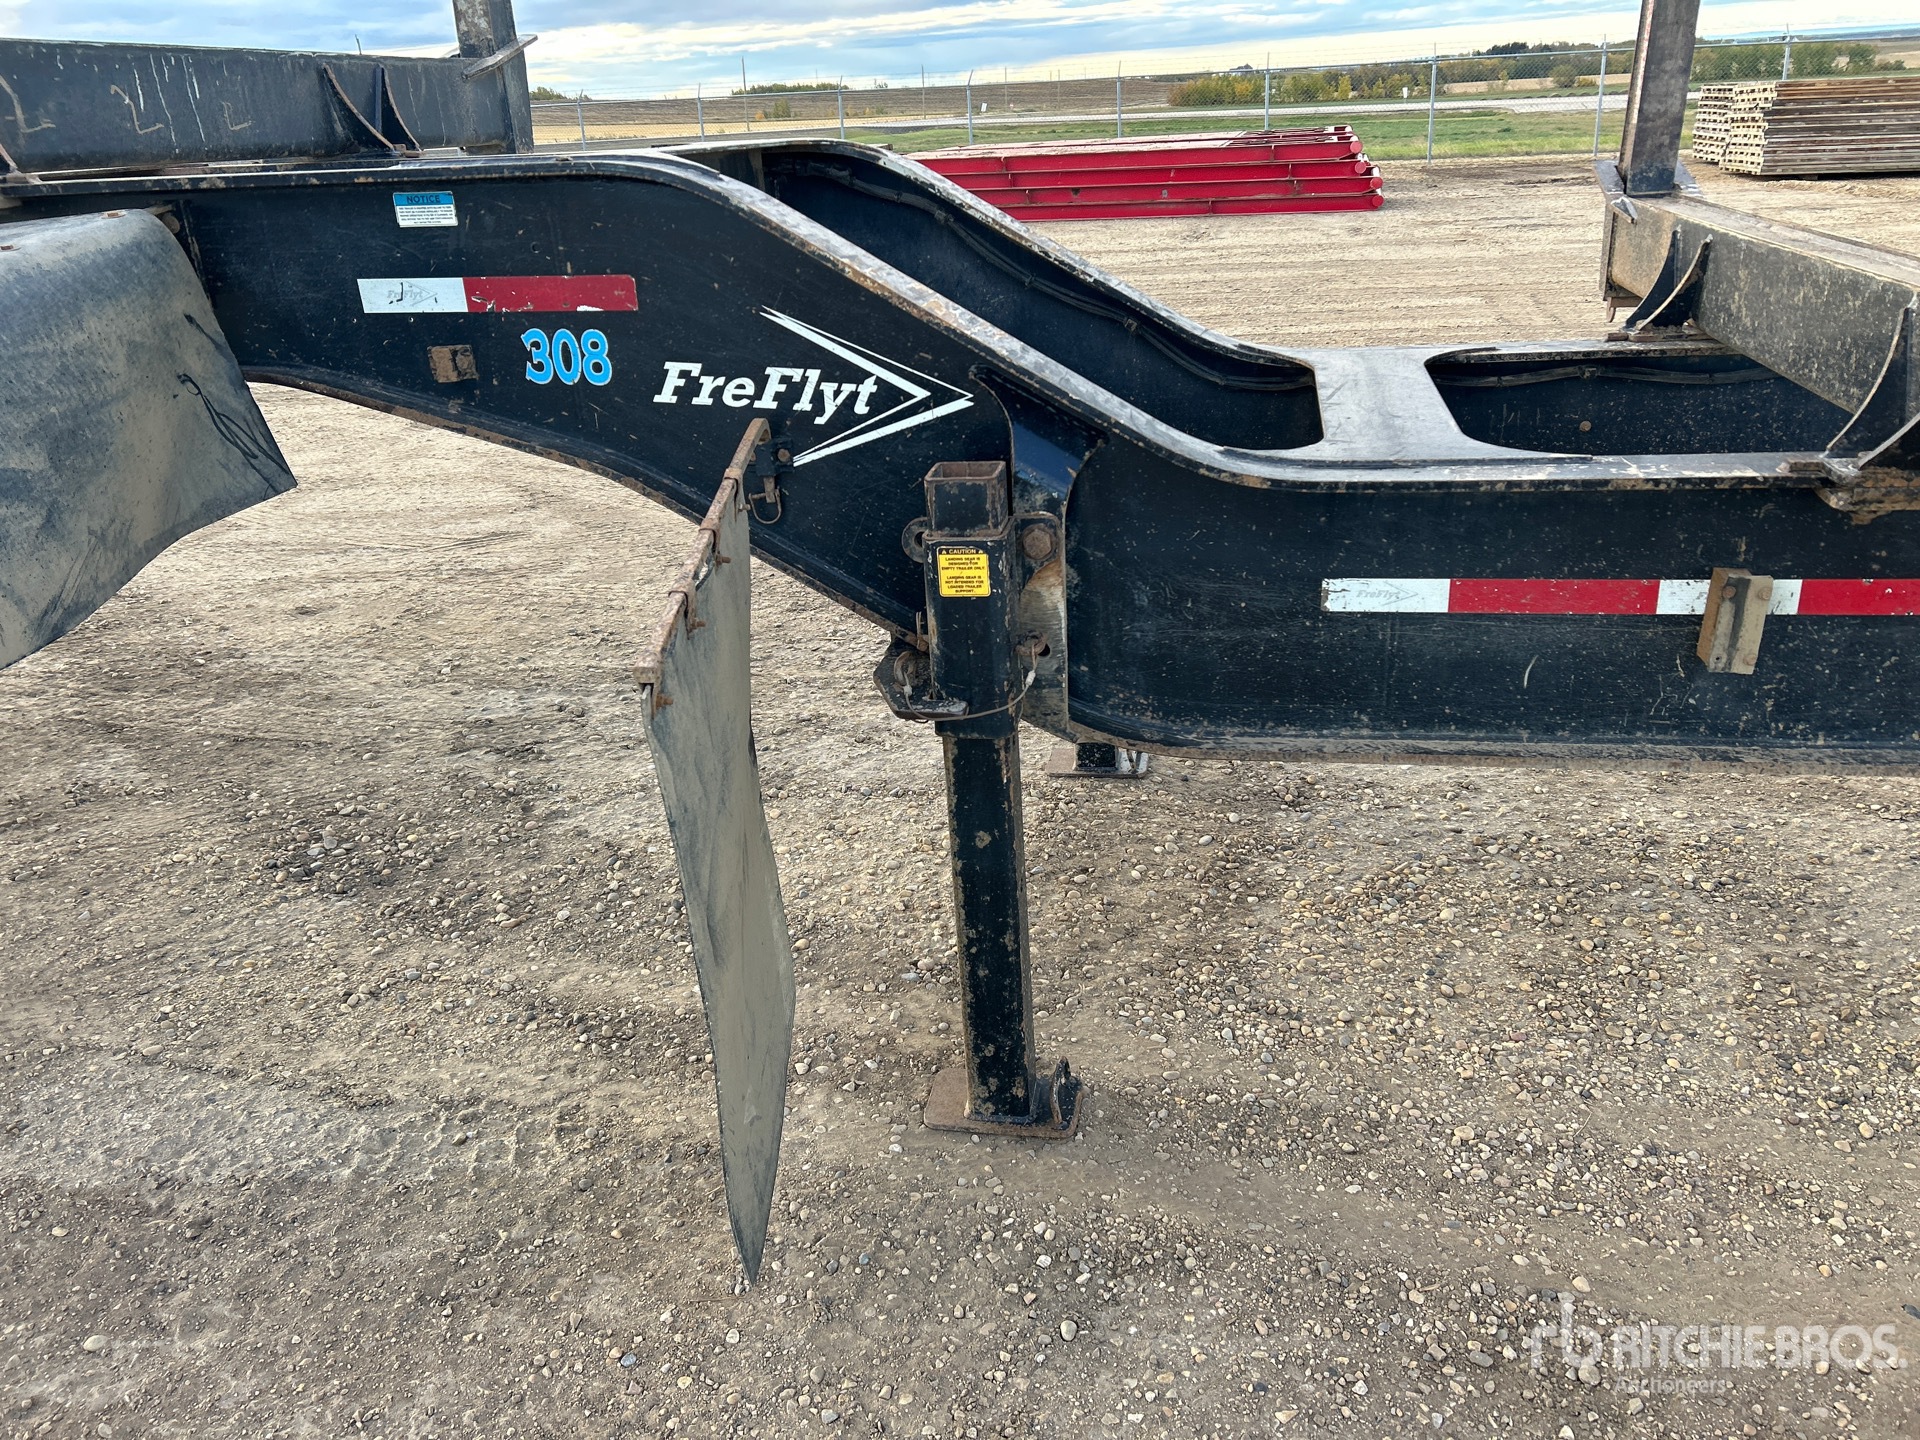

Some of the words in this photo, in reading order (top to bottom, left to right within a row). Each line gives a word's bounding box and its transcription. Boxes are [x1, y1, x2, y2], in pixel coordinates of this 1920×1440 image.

[406, 194, 440, 203] NOTICE
[387, 289, 423, 300] FrFlyt
[520, 328, 613, 386] 308
[652, 361, 878, 425] FreFlyt
